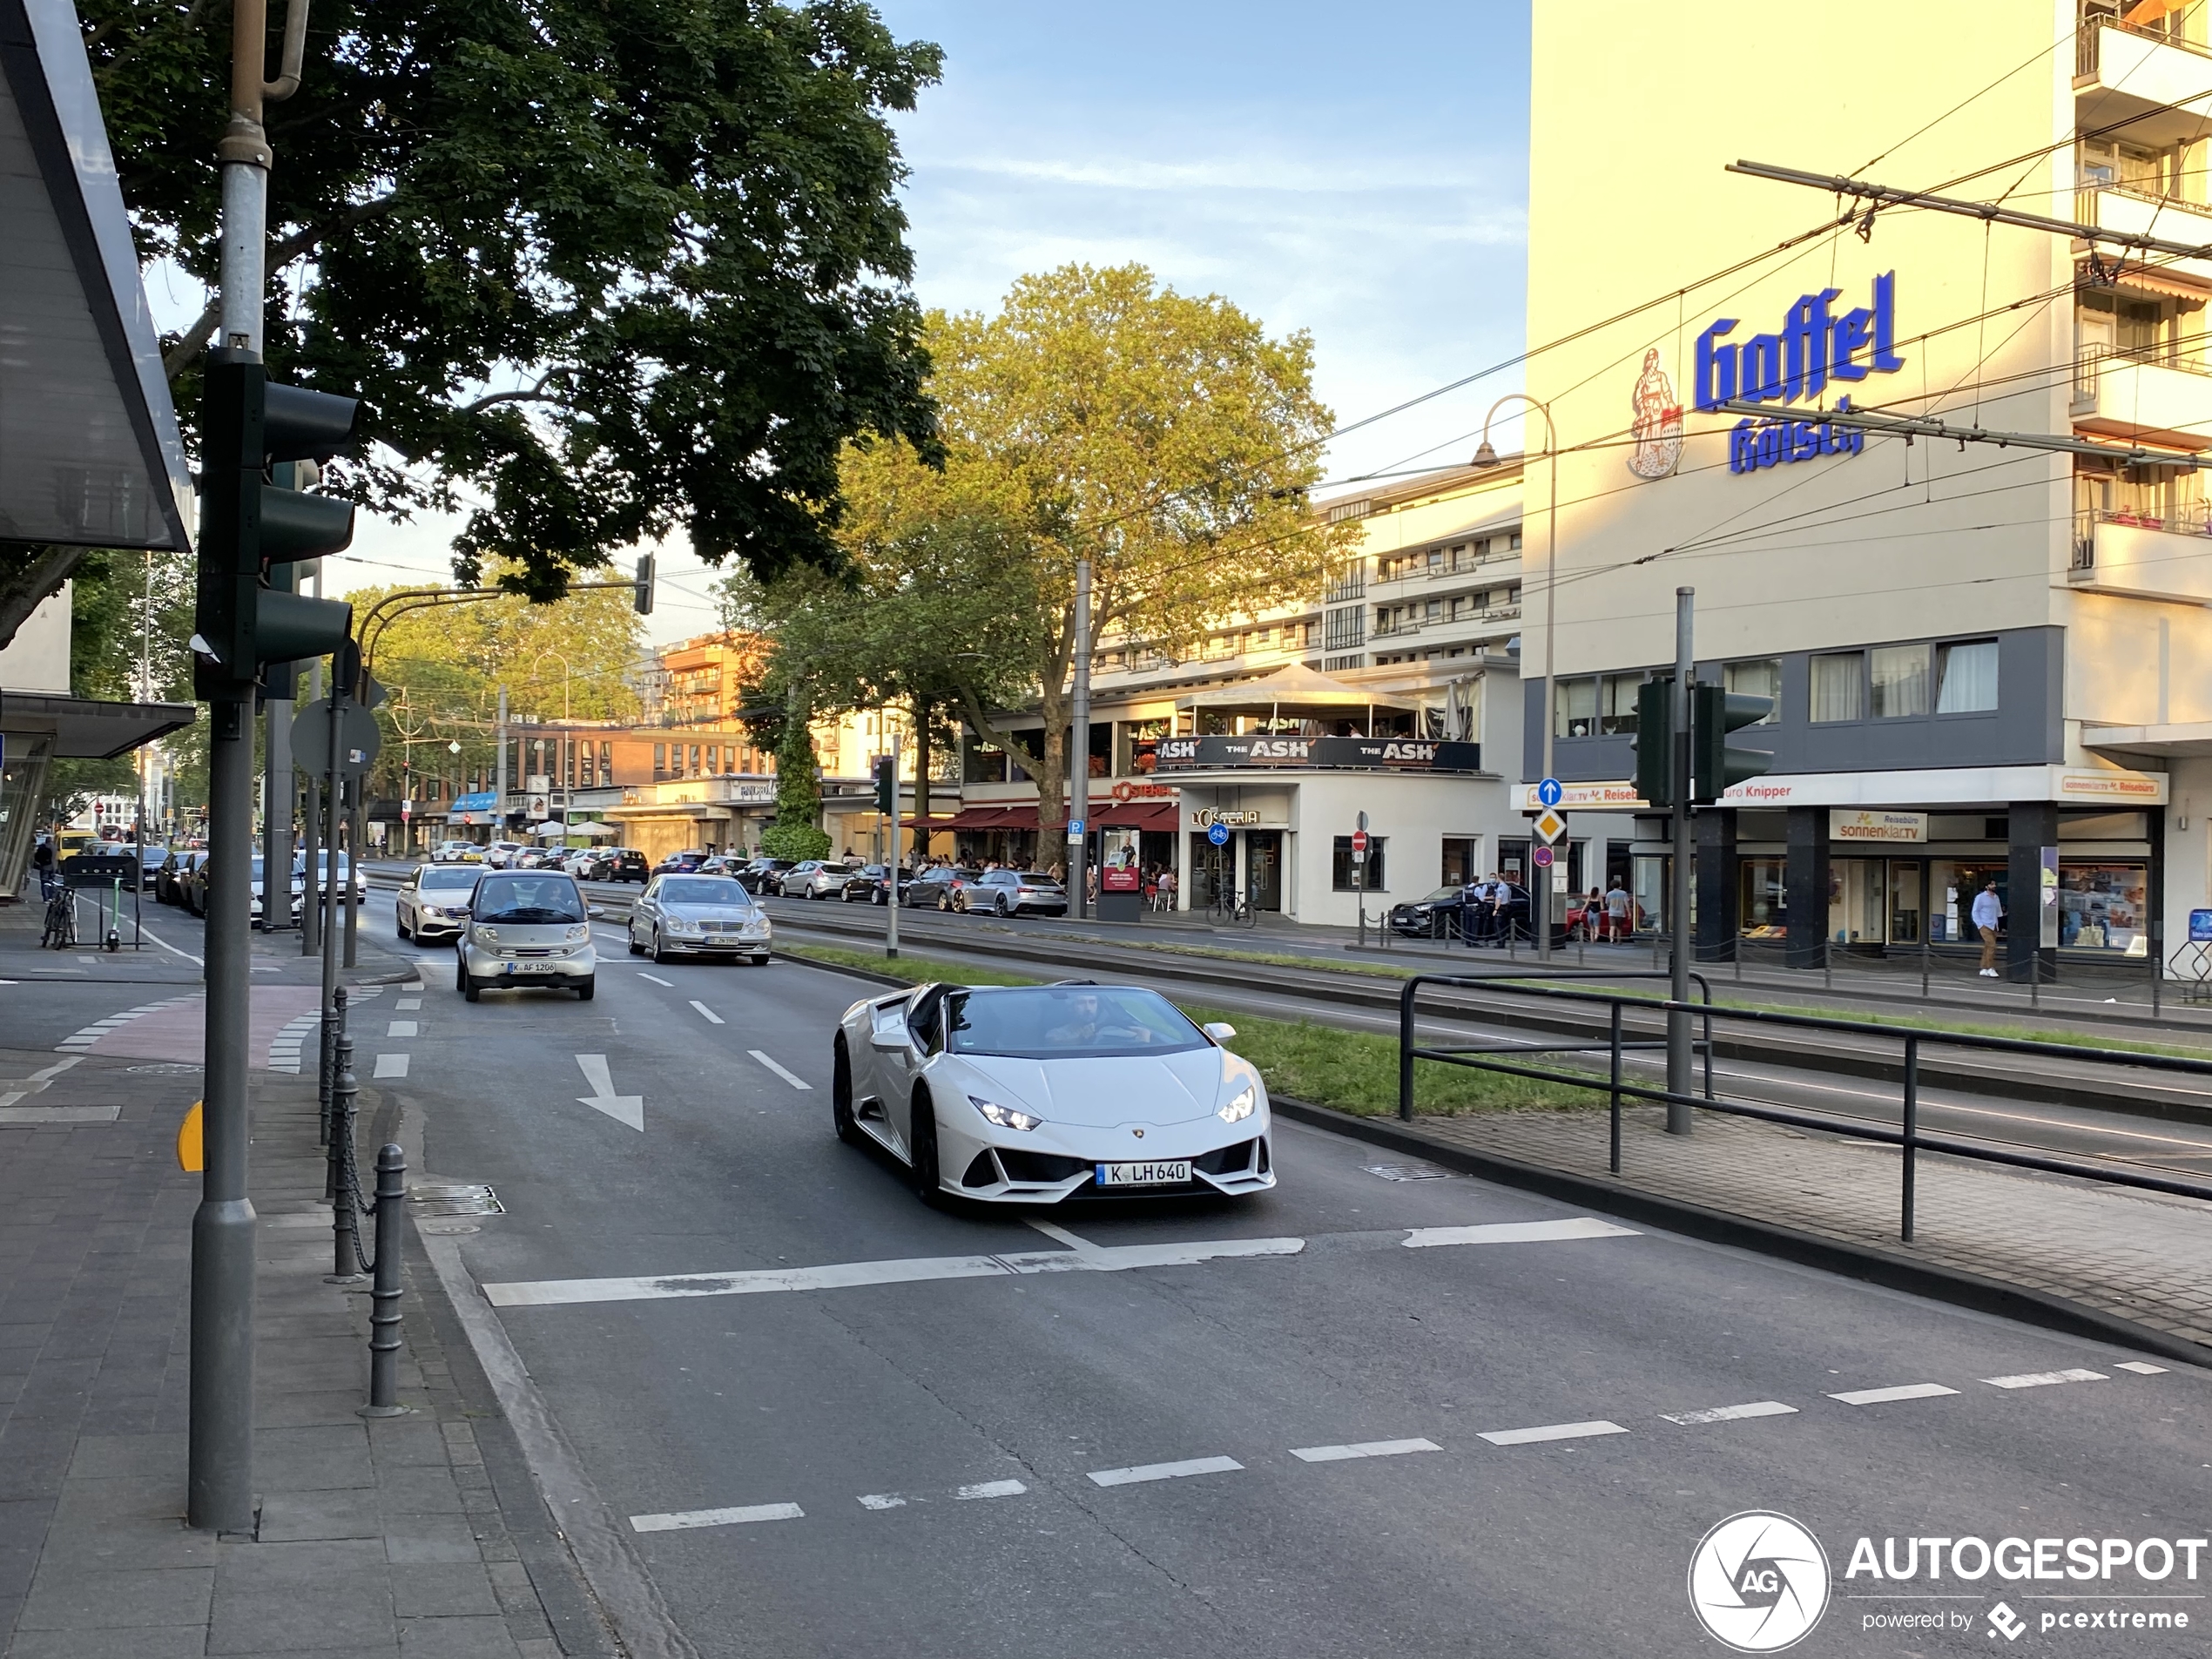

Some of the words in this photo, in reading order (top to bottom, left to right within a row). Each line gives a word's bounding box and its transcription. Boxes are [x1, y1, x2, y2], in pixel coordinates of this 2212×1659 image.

[1694, 269, 1906, 414] Gaffel
[1161, 741, 1195, 758] ASH
[1250, 741, 1308, 757] ASH
[1382, 743, 1433, 760] ASH
[1745, 786, 1791, 800] Knipper
[2120, 781, 2155, 792] Reisebüro
[1531, 789, 1588, 802] soklar.TV
[1604, 789, 1637, 800] Reiseb
[1884, 814, 1919, 825] Reisebüro
[1840, 824, 1918, 839] sonnenklar.TV
[1111, 1165, 1122, 1182] K
